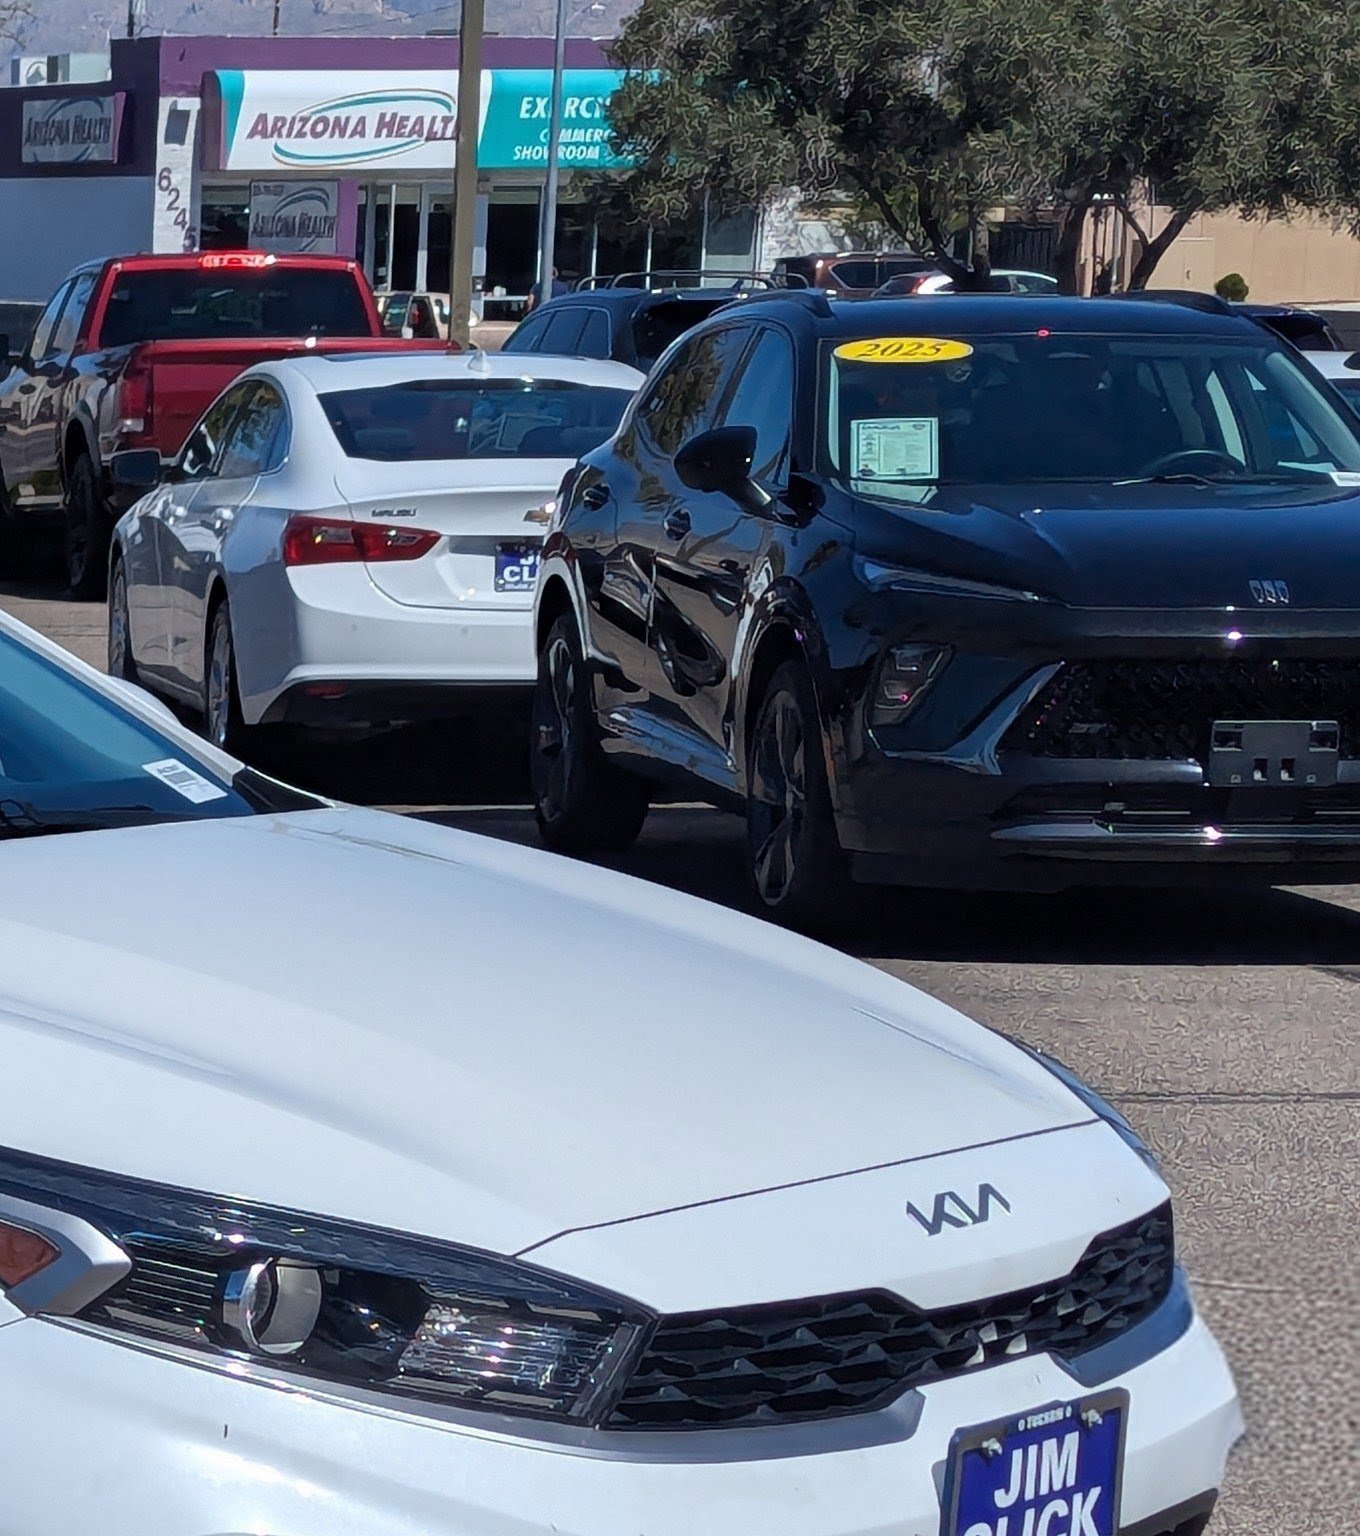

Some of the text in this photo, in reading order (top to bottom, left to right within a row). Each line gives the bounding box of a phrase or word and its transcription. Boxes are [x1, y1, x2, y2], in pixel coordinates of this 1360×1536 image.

[246, 112, 367, 140] ARIZONA
[857, 341, 948, 358] 2025
[906, 1182, 1012, 1237] KIA
[994, 1431, 1080, 1509] JIM
